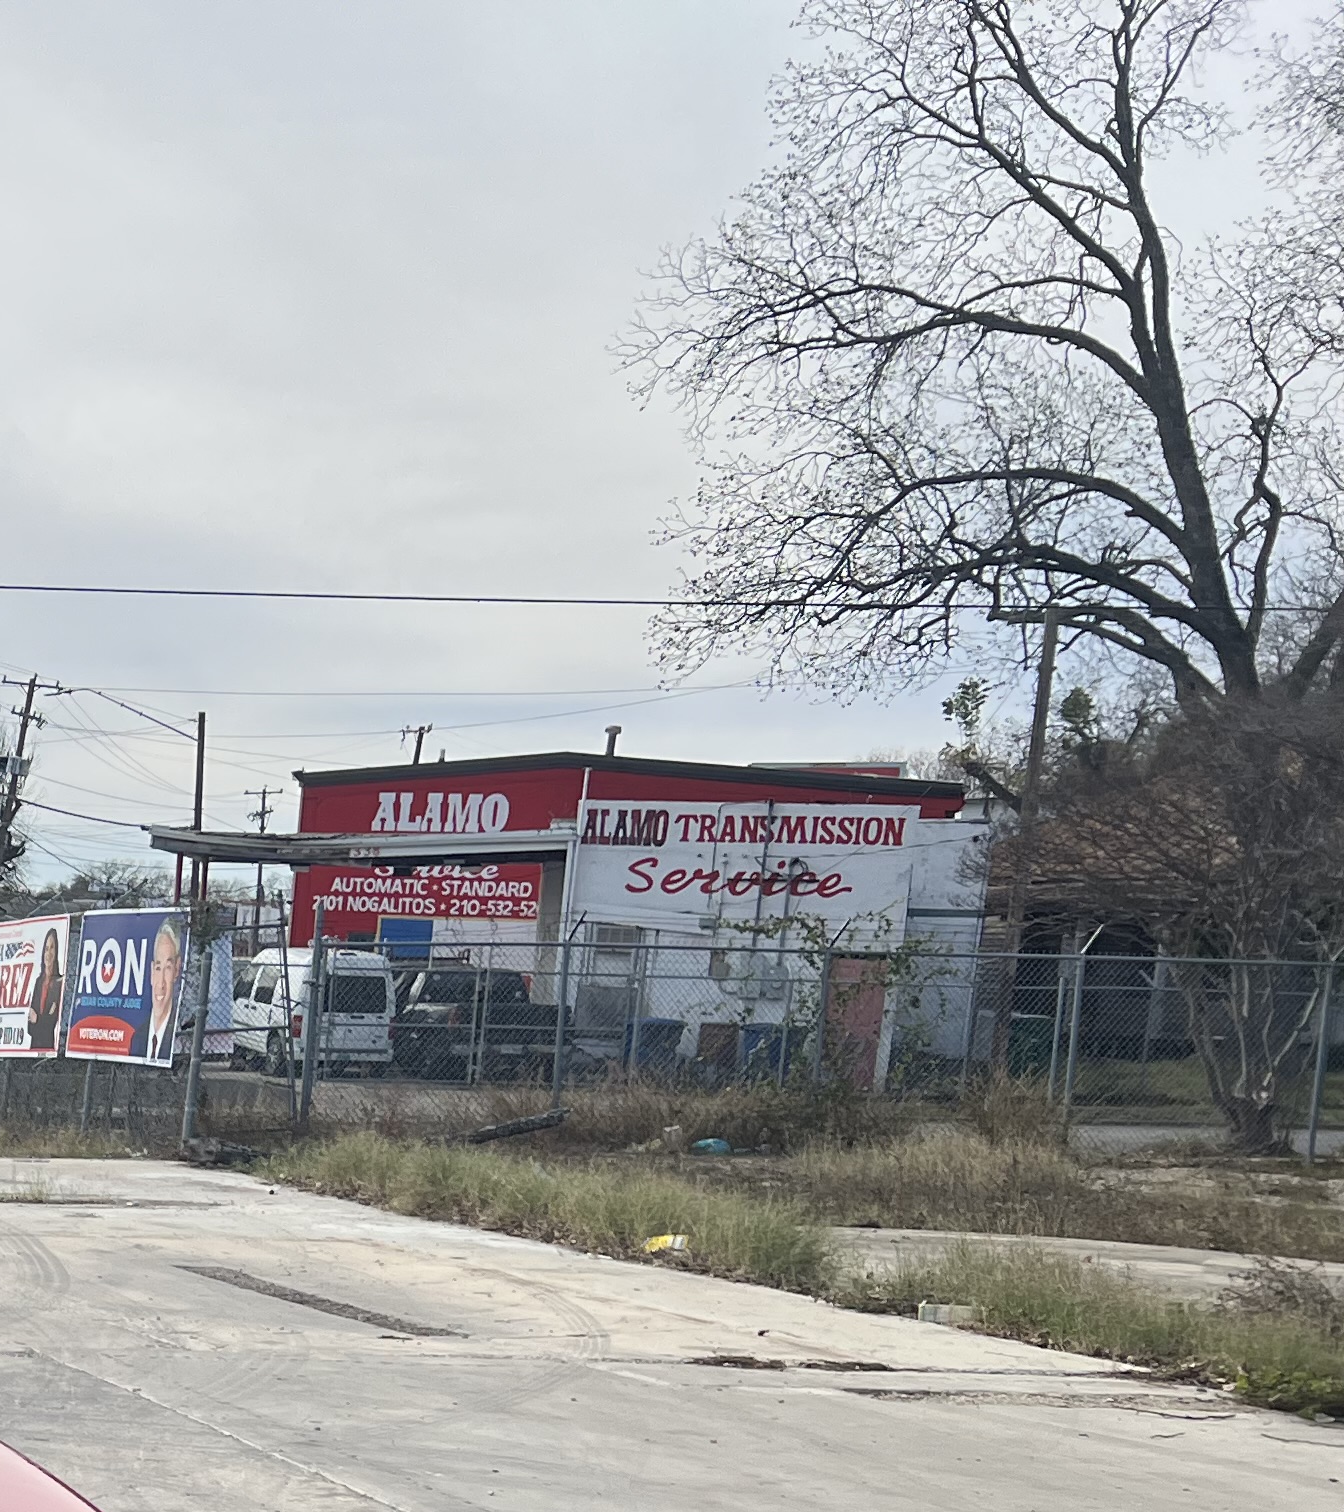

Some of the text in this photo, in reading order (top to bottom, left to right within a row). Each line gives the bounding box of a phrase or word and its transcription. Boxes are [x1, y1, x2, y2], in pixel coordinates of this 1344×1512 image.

[371, 791, 510, 833] ALAMO
[580, 808, 907, 848] ALAMO TRANSMISSION
[330, 876, 533, 899] AUTOMATIC STANDARD
[624, 857, 853, 899] Service
[312, 894, 344, 912] 2101
[347, 896, 436, 915] NOGALITOS
[77, 937, 148, 996] RON
